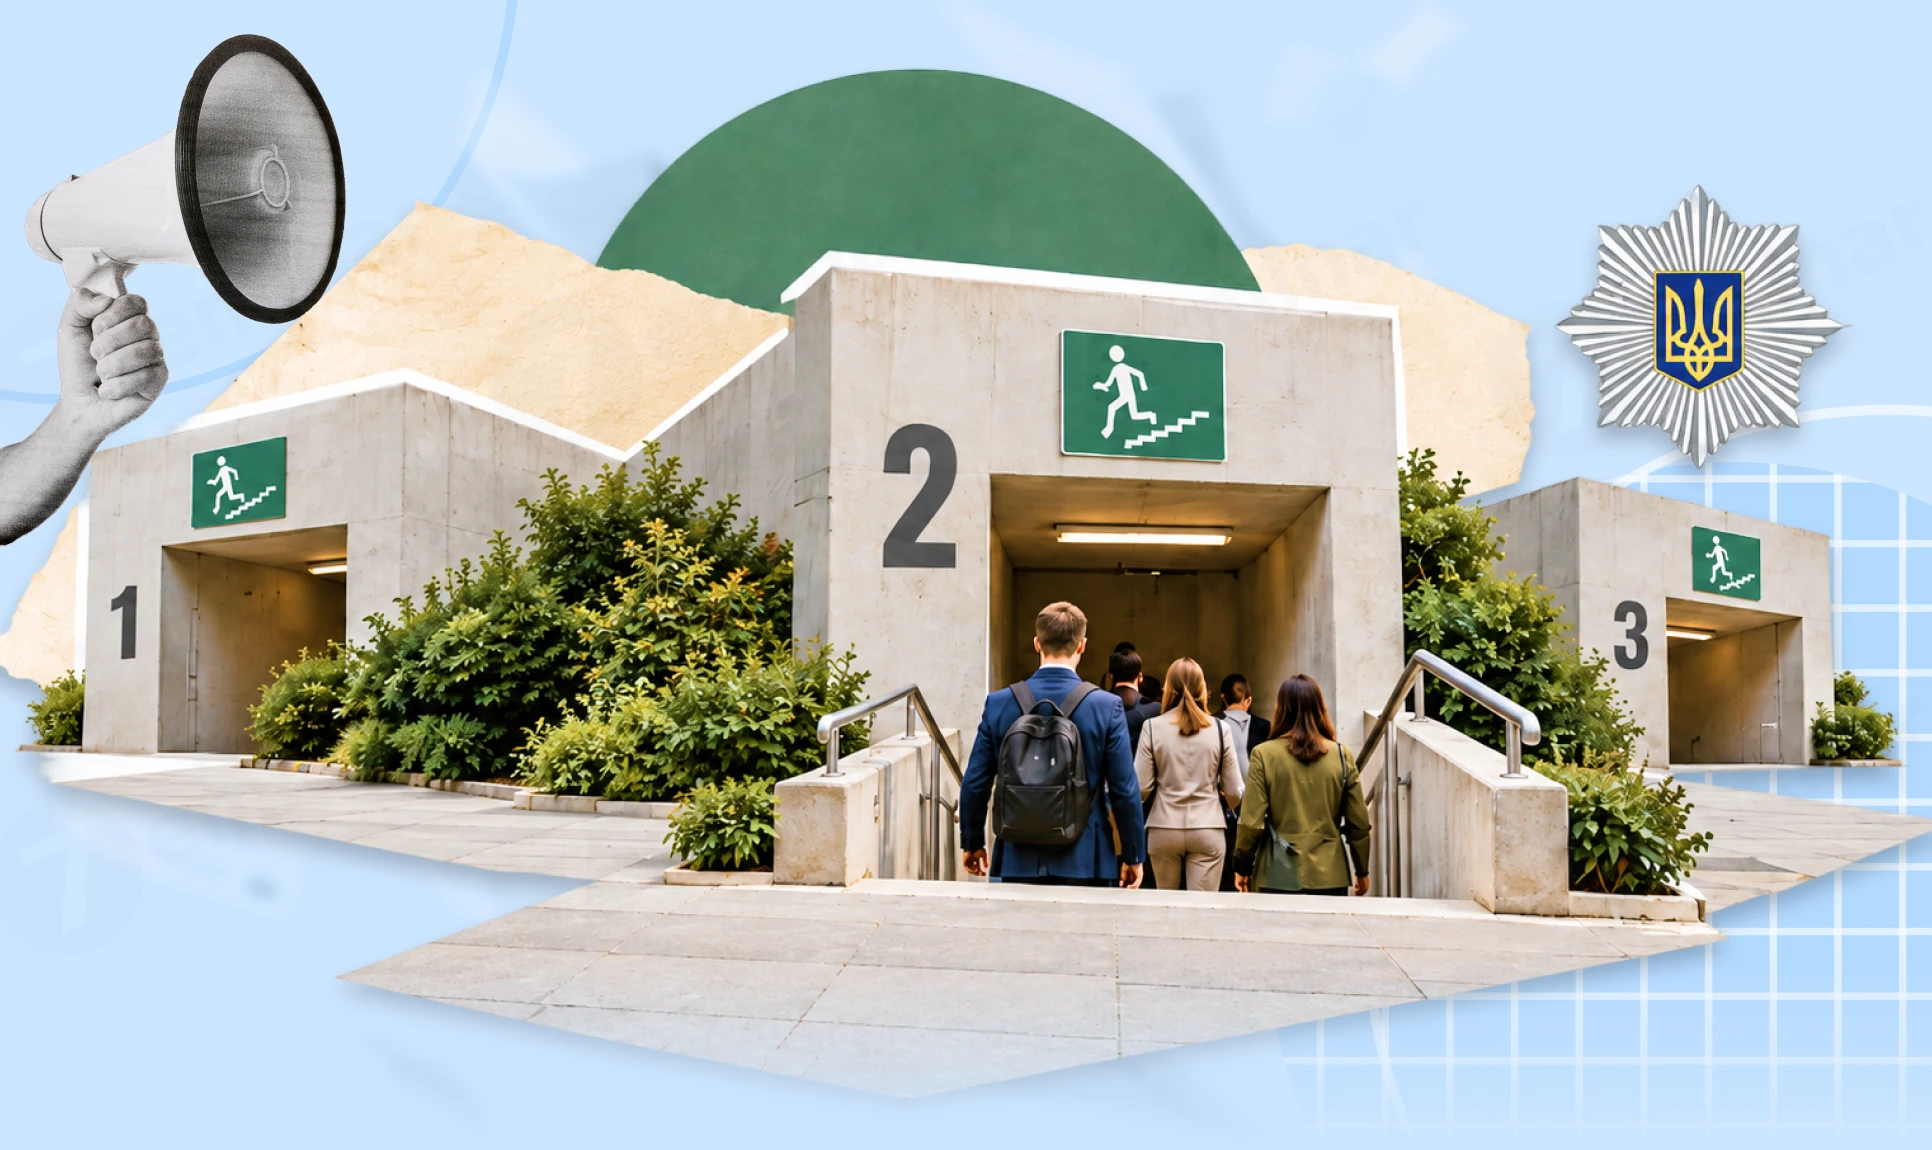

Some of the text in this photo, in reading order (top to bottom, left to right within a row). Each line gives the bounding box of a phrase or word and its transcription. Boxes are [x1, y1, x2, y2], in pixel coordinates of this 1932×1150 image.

[883, 423, 957, 568] 2
[111, 585, 137, 659] 1
[1614, 600, 1648, 670] 3
